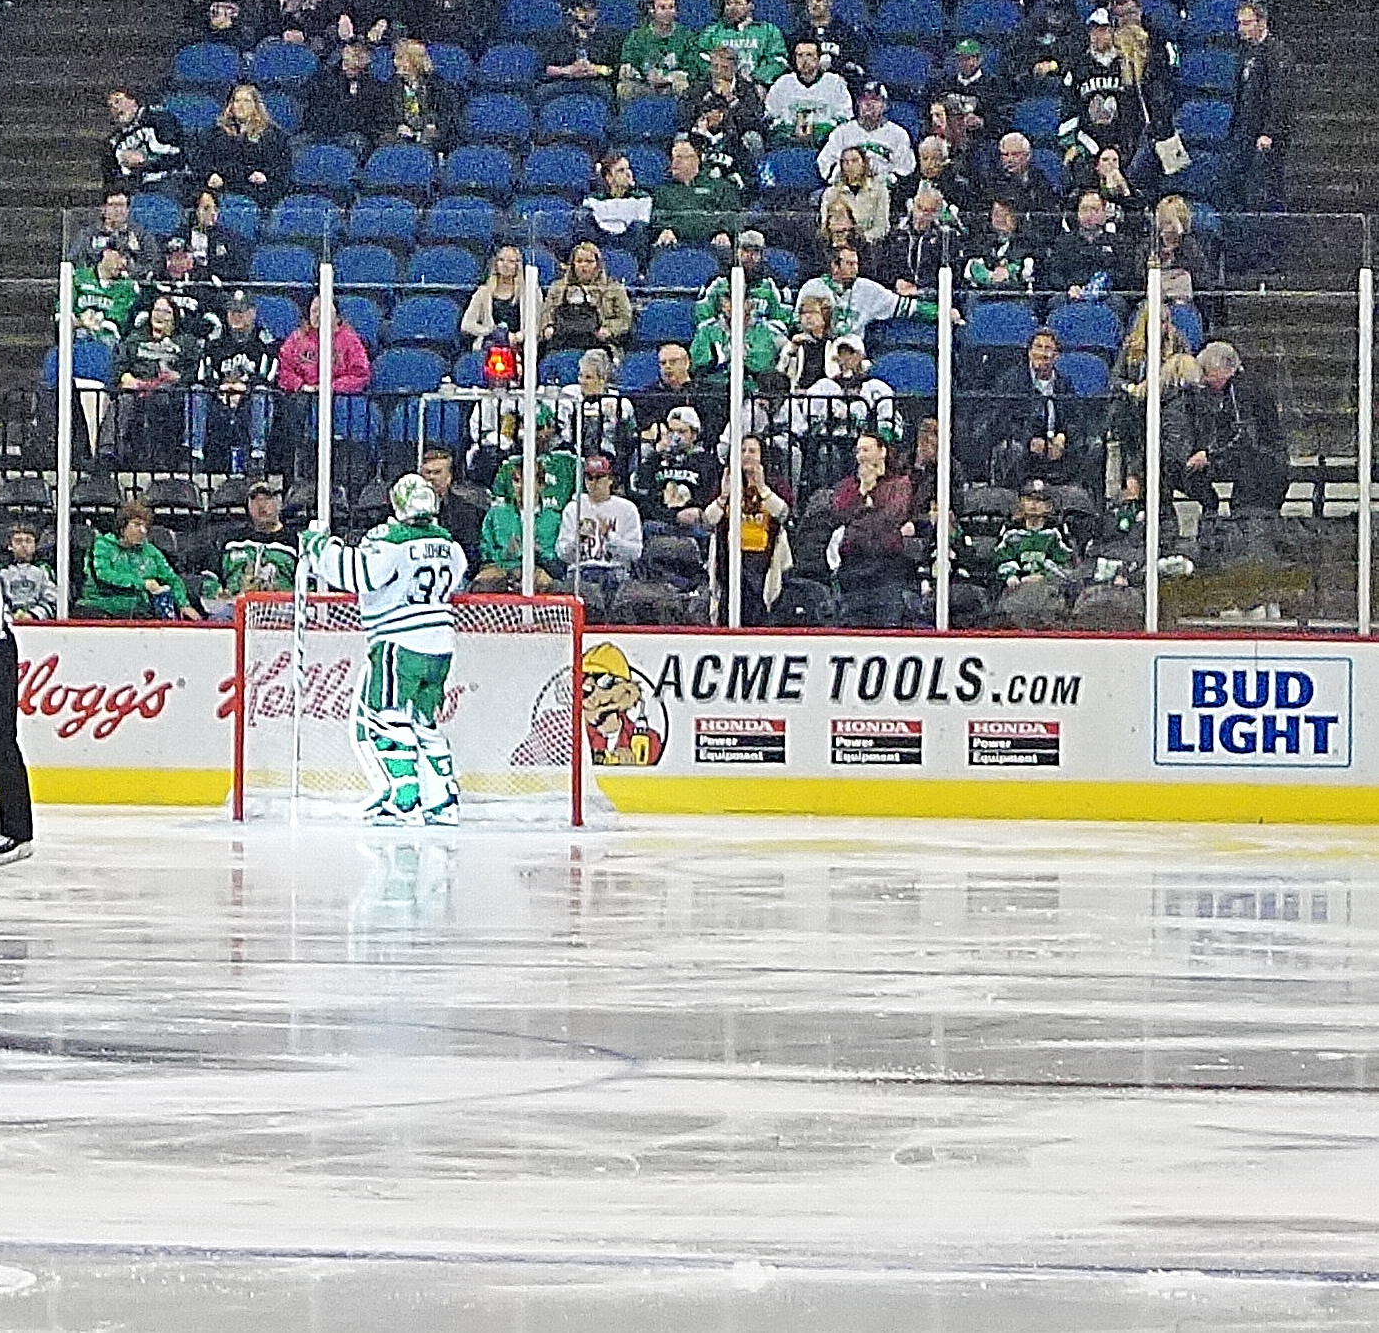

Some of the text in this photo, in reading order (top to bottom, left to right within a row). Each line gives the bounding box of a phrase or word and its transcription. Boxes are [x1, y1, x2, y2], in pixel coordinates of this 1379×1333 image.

[652, 653, 805, 706] ACME
[17, 652, 174, 740] llogg's
[1191, 669, 1314, 712] BUD
[699, 720, 775, 732] HONDA
[835, 722, 911, 733] HONDA
[971, 723, 1048, 734] HONDA
[1167, 714, 1341, 757] LIGHT
[699, 750, 764, 763] Equipment
[835, 751, 901, 764] Equipment
[972, 753, 1039, 765] Equipment
